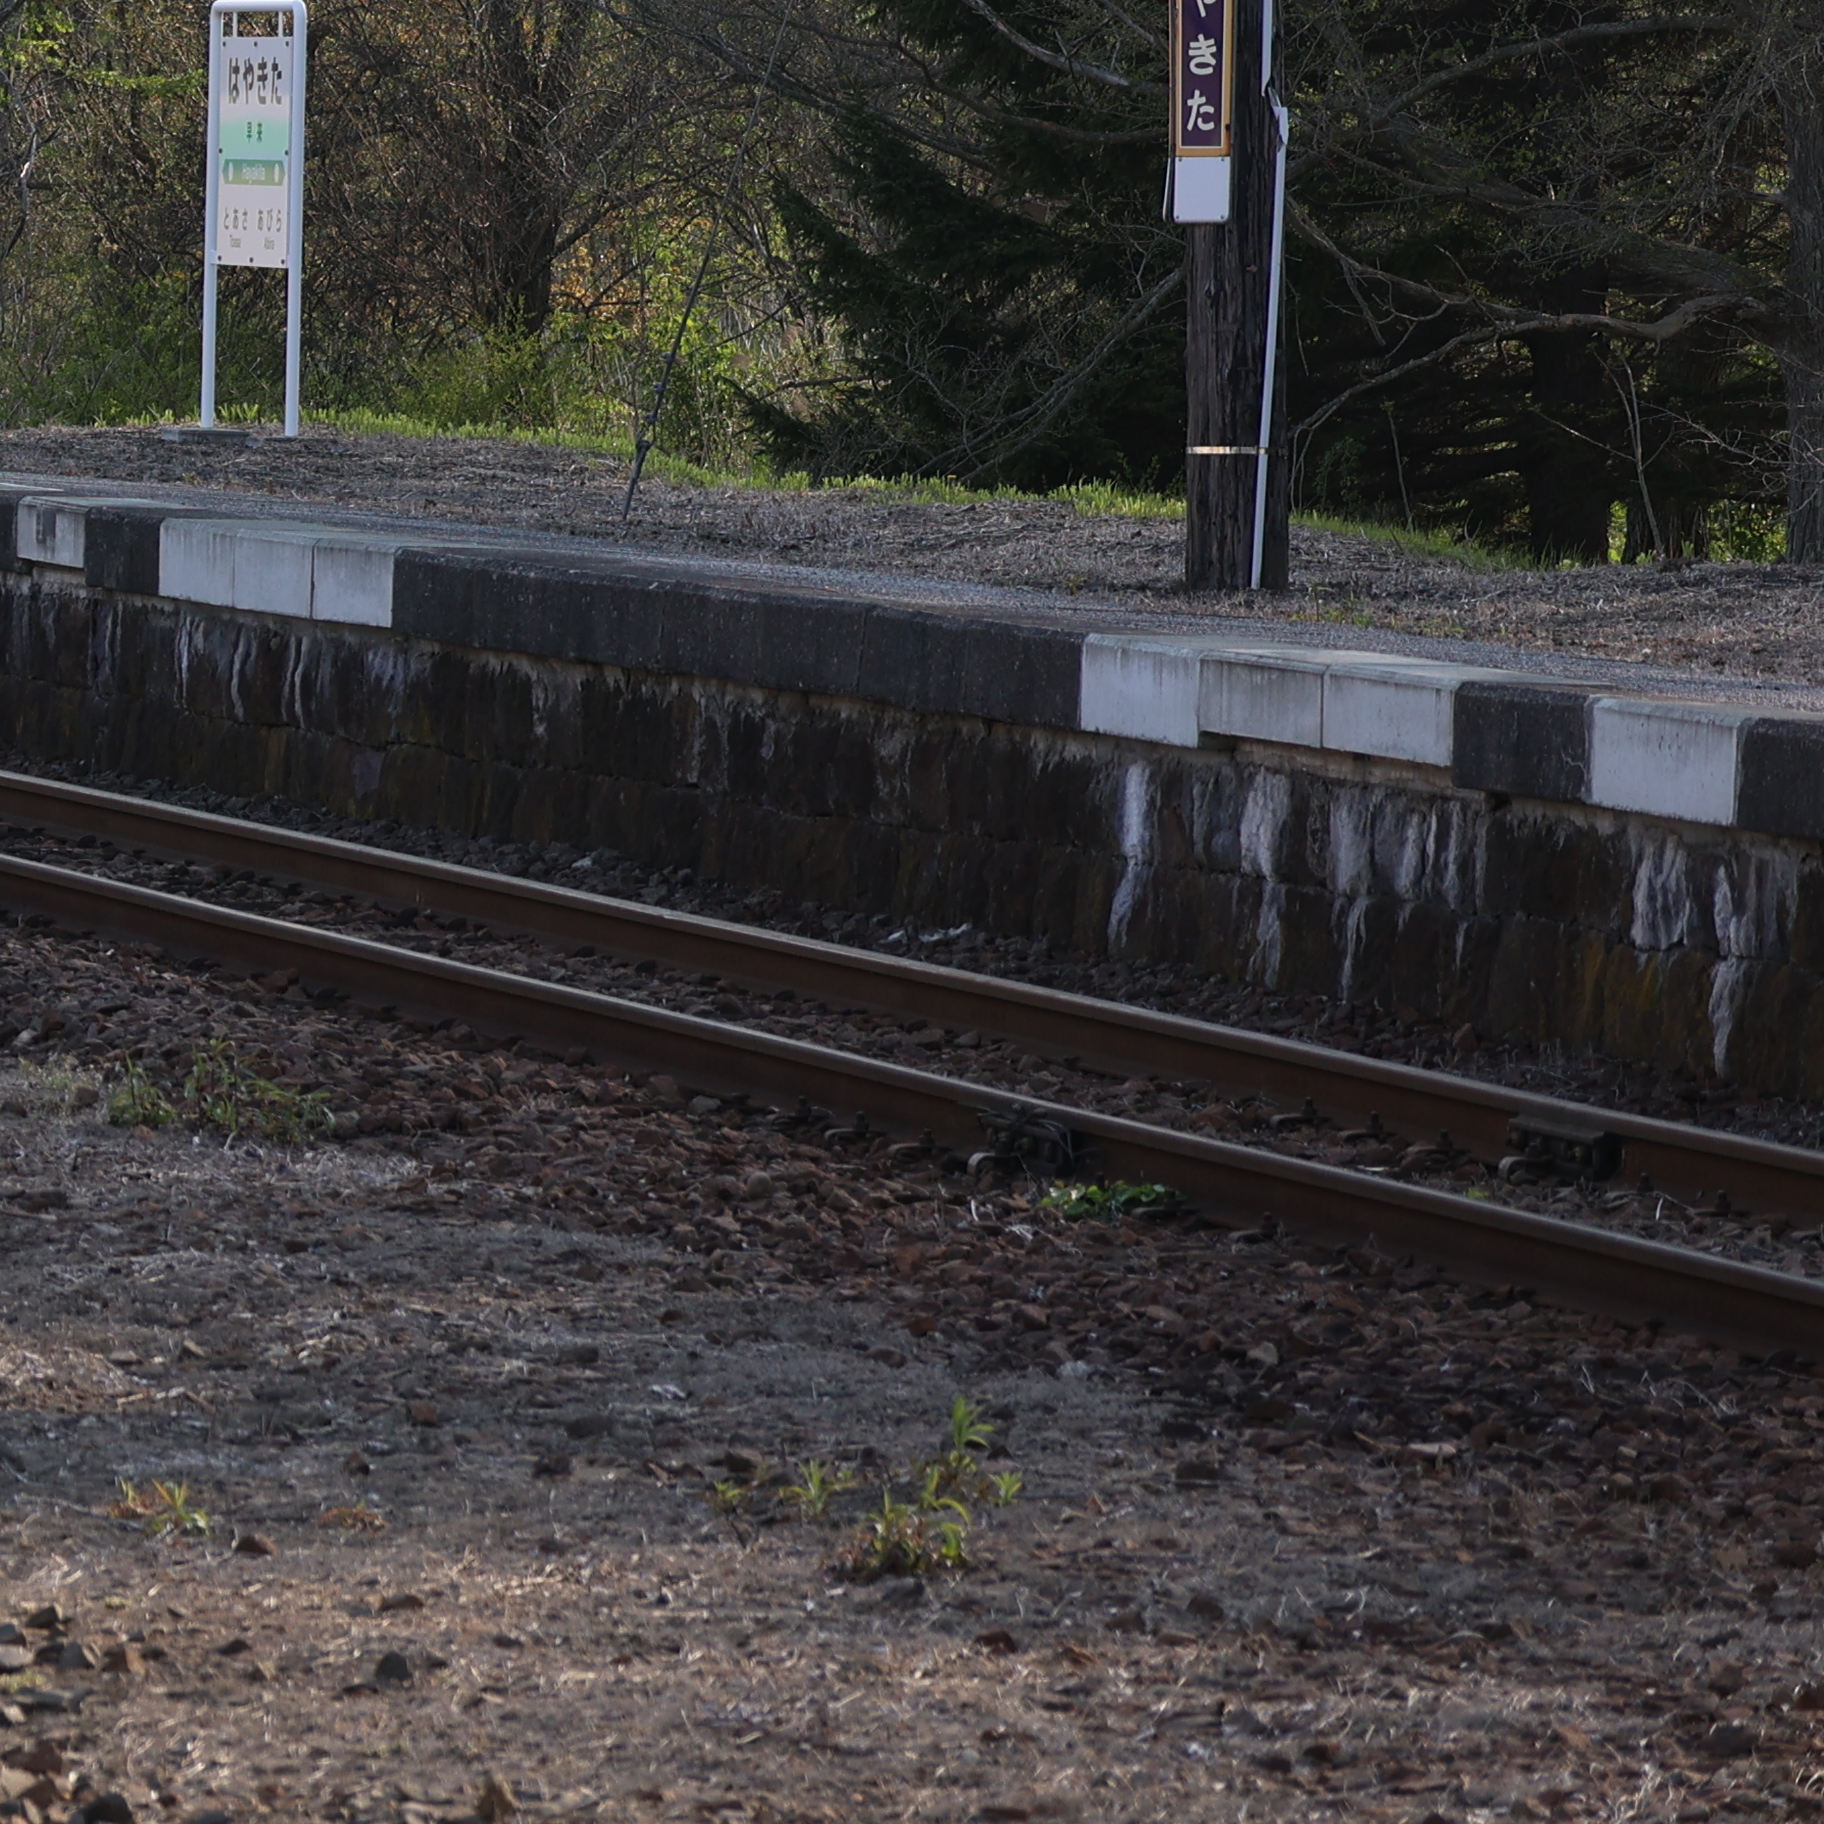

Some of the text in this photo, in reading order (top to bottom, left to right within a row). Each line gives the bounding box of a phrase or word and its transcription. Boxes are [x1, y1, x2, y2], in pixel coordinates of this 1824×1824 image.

[228, 56, 283, 105] はやきた
[223, 206, 282, 233] とあさ あびら
